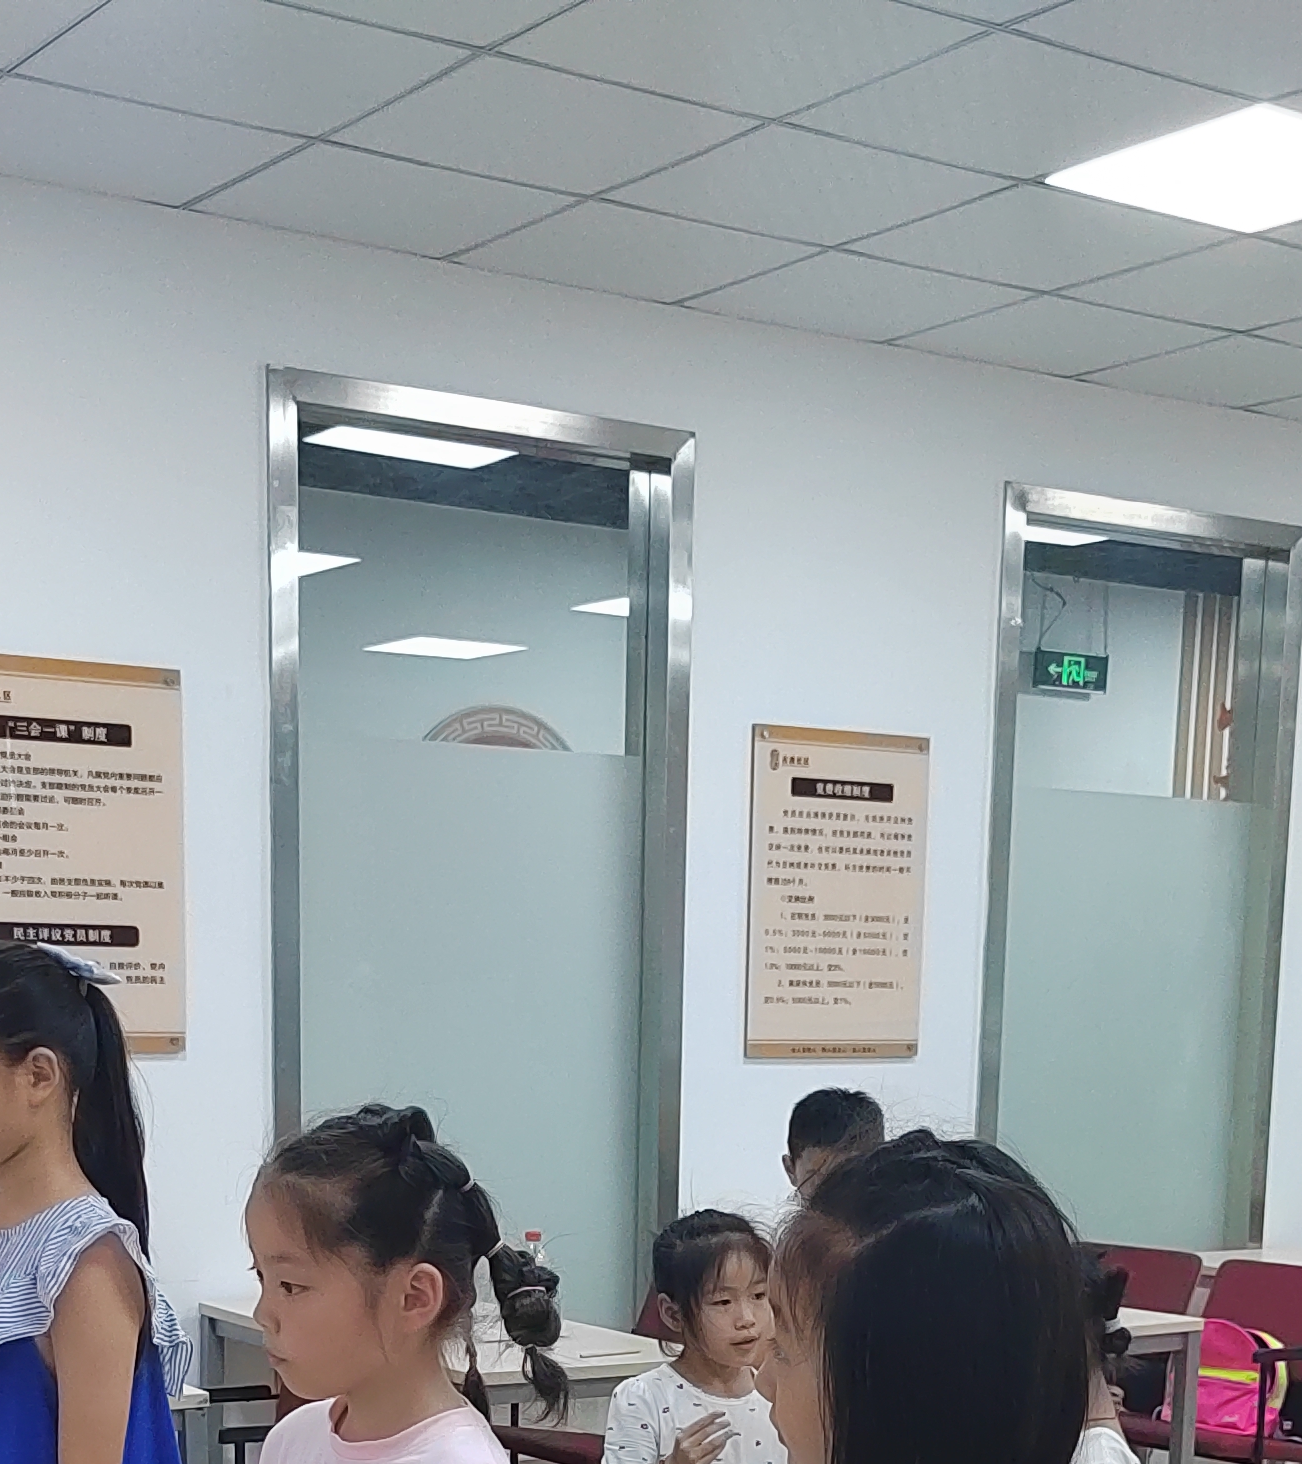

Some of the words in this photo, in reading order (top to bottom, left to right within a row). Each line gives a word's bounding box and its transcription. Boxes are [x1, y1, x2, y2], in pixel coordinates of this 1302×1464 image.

[12, 926, 113, 944] 民主评议党员制度
